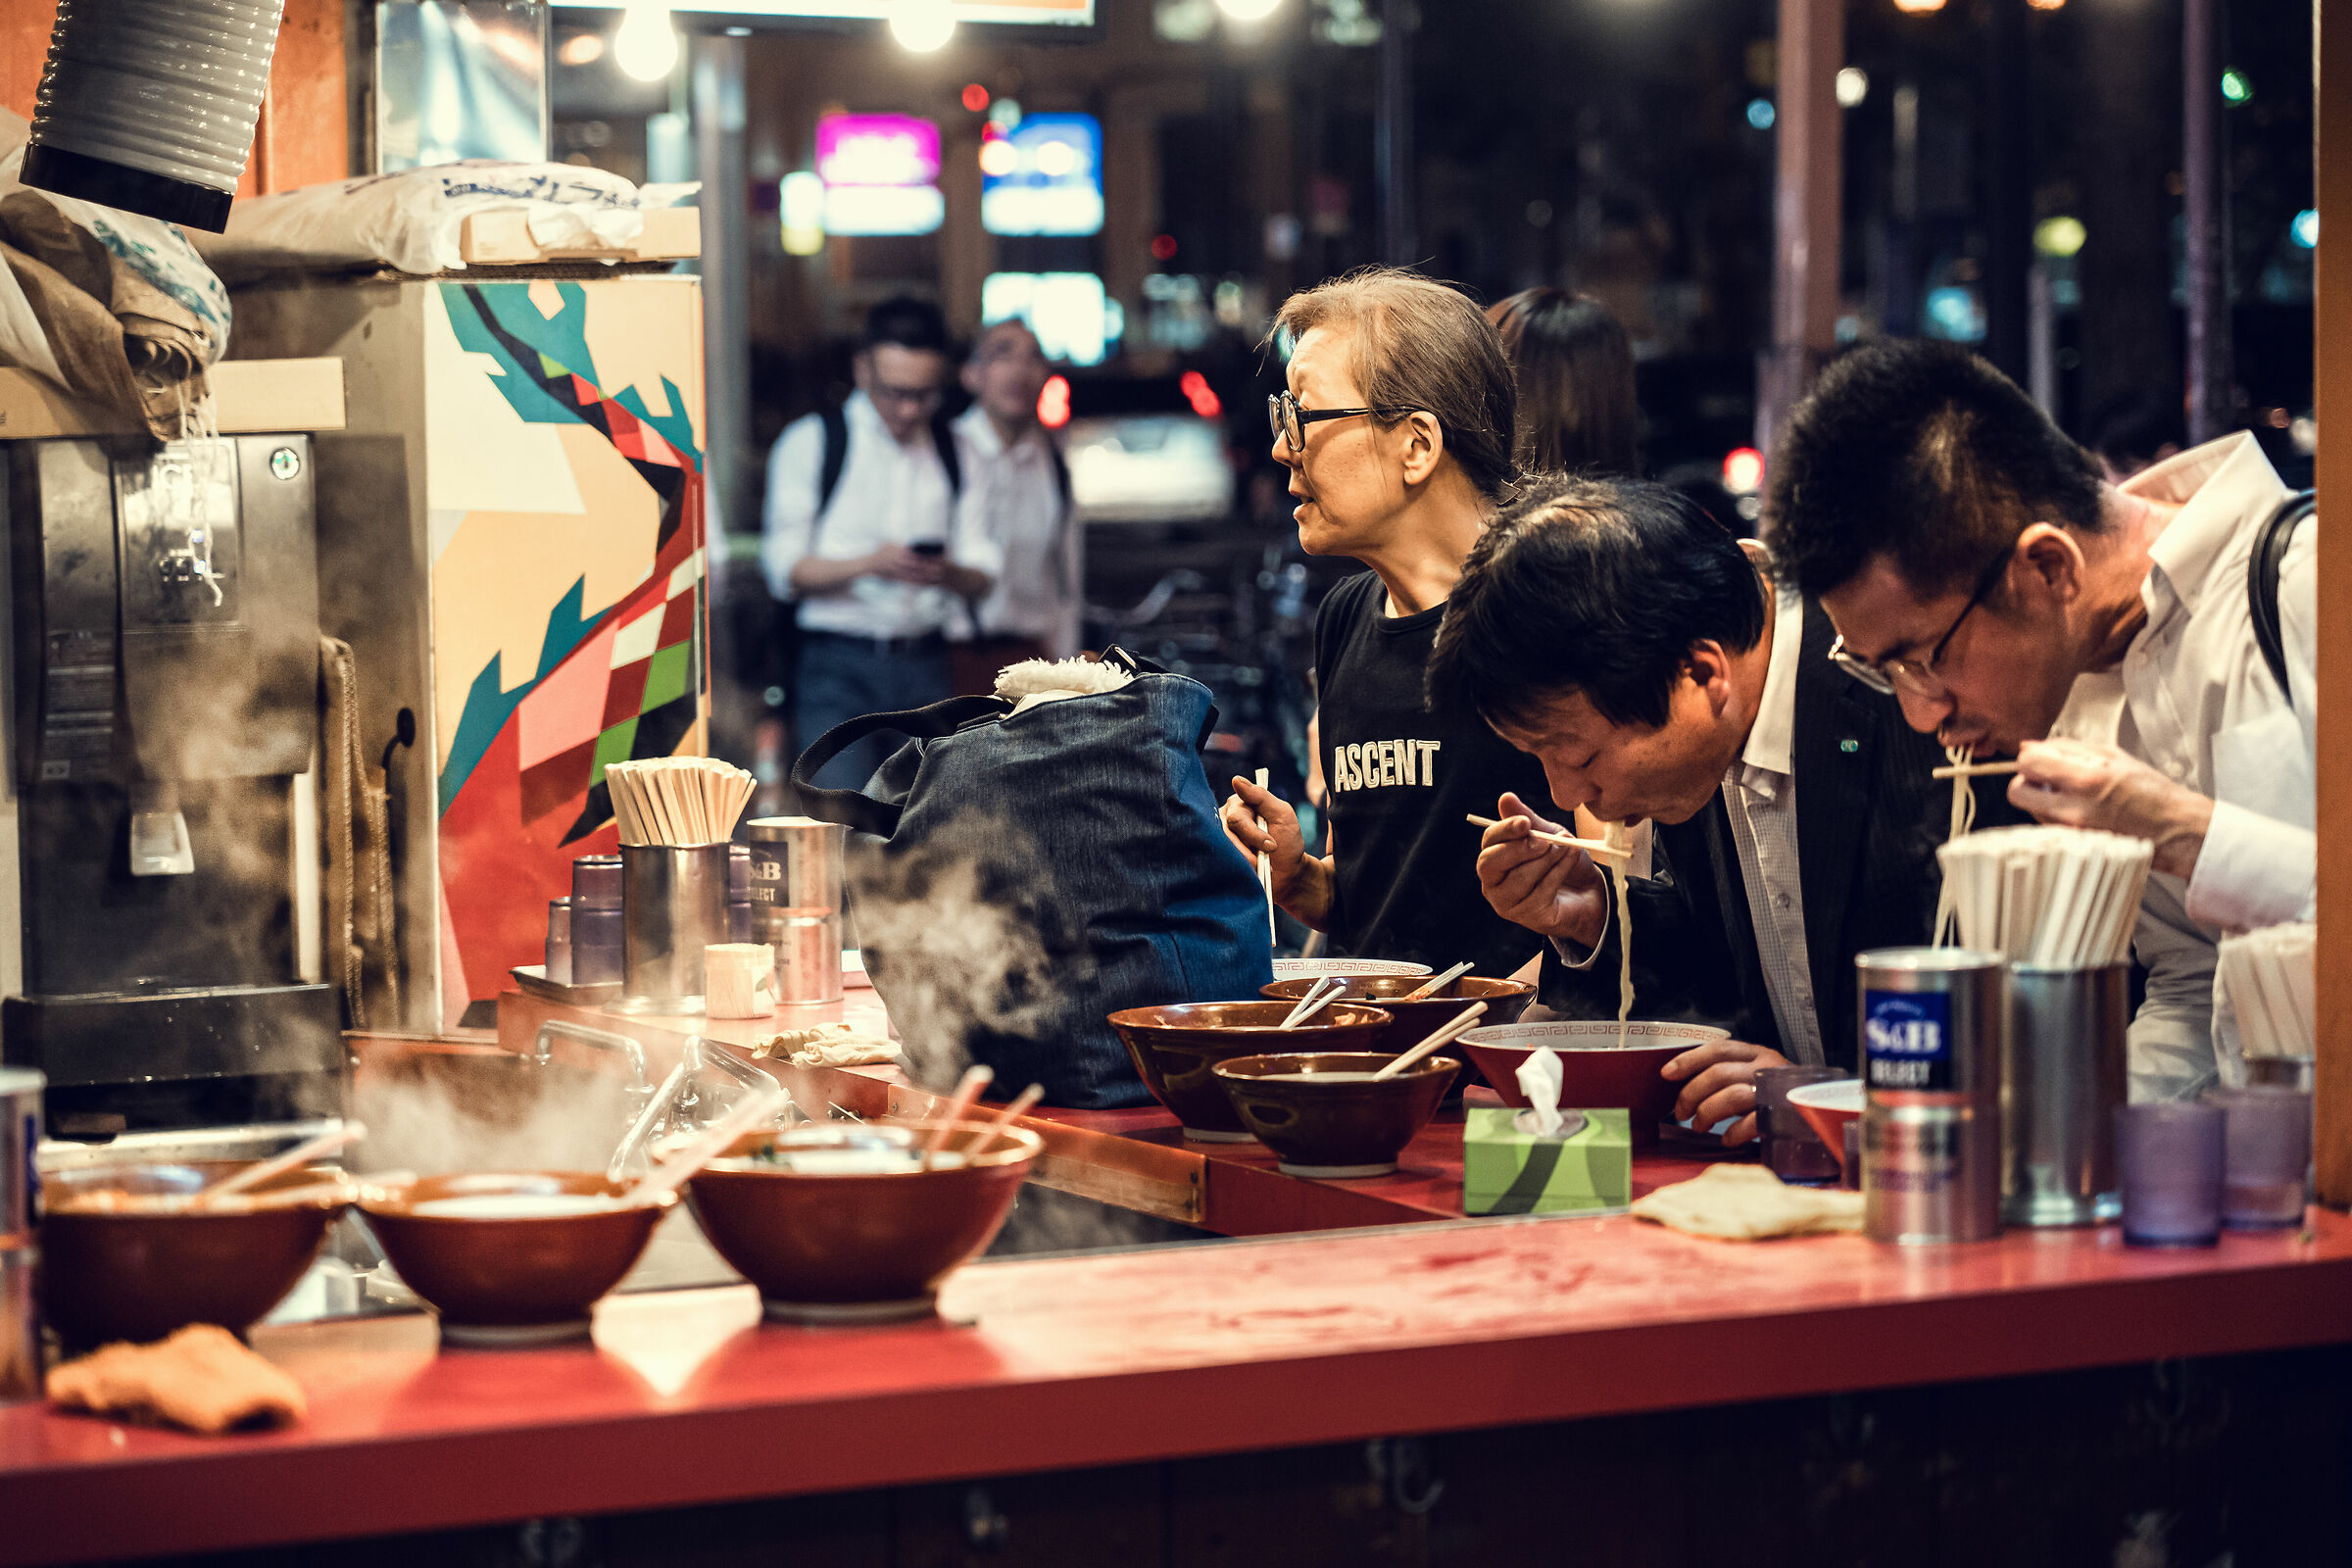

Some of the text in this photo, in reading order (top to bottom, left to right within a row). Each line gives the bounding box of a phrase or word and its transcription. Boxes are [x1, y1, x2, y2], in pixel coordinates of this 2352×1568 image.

[1335, 739, 1441, 793] ASCENT
[748, 886, 776, 902] LECT
[1865, 1017, 1941, 1054] S&B
